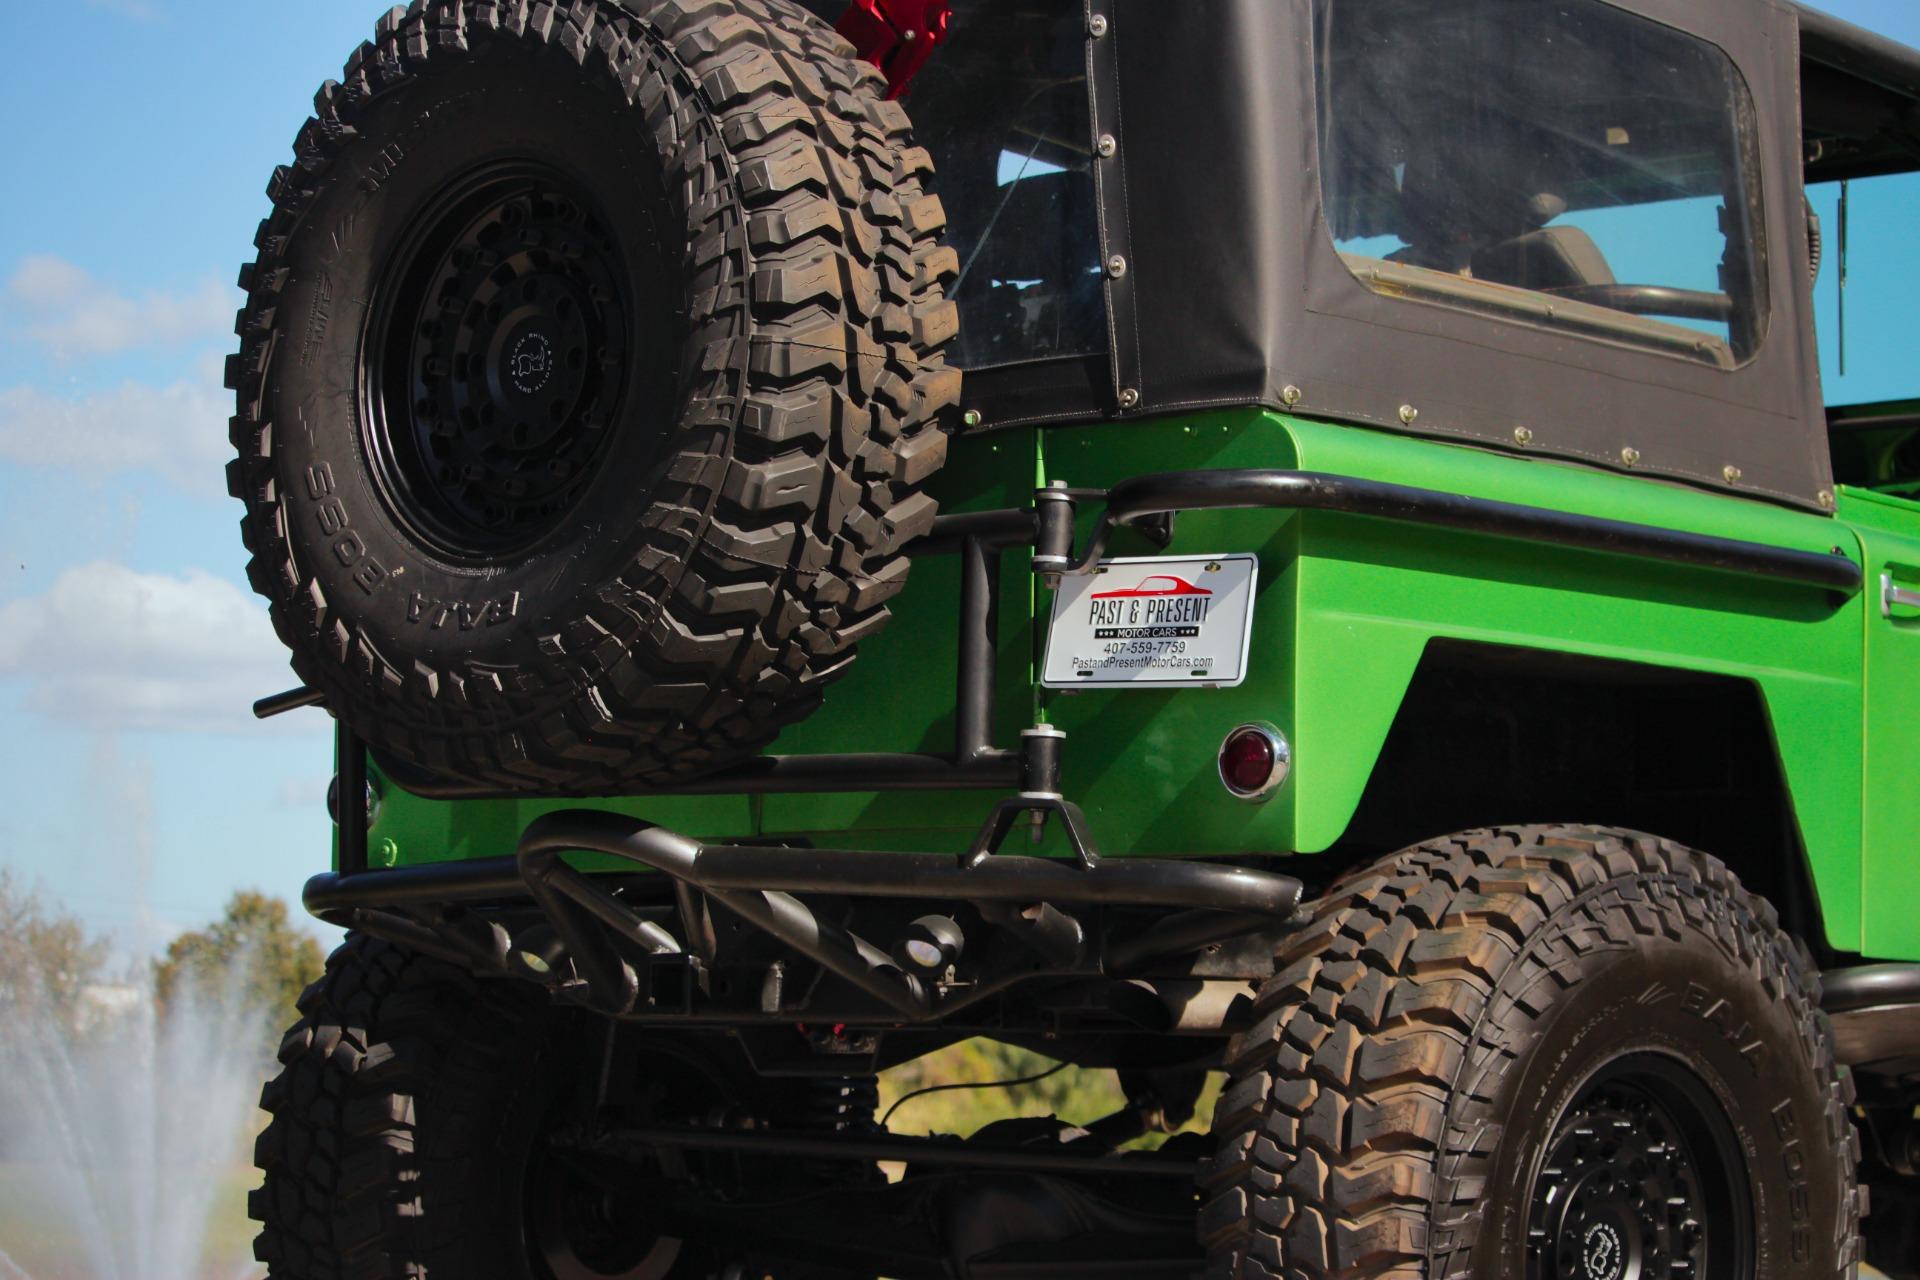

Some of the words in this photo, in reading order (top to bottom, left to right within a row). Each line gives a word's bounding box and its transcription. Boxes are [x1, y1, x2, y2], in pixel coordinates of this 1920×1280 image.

[510, 336, 525, 365] BLACK
[528, 332, 548, 346] RHINO
[513, 379, 532, 393] HARD
[304, 459, 390, 595] BOSS
[407, 590, 520, 631] BAJA
[1089, 599, 1124, 625] PAST
[1130, 600, 1140, 624] &
[1146, 597, 1211, 624] PRESENT
[1117, 628, 1150, 638] MOTOR
[1152, 627, 1177, 637] CARS
[1104, 641, 1186, 654] 407-559-7759
[1072, 655, 1213, 669] PastandPresentMotorCars.com
[1680, 981, 1767, 1079] BAJA
[1771, 1097, 1812, 1264] BOSS
